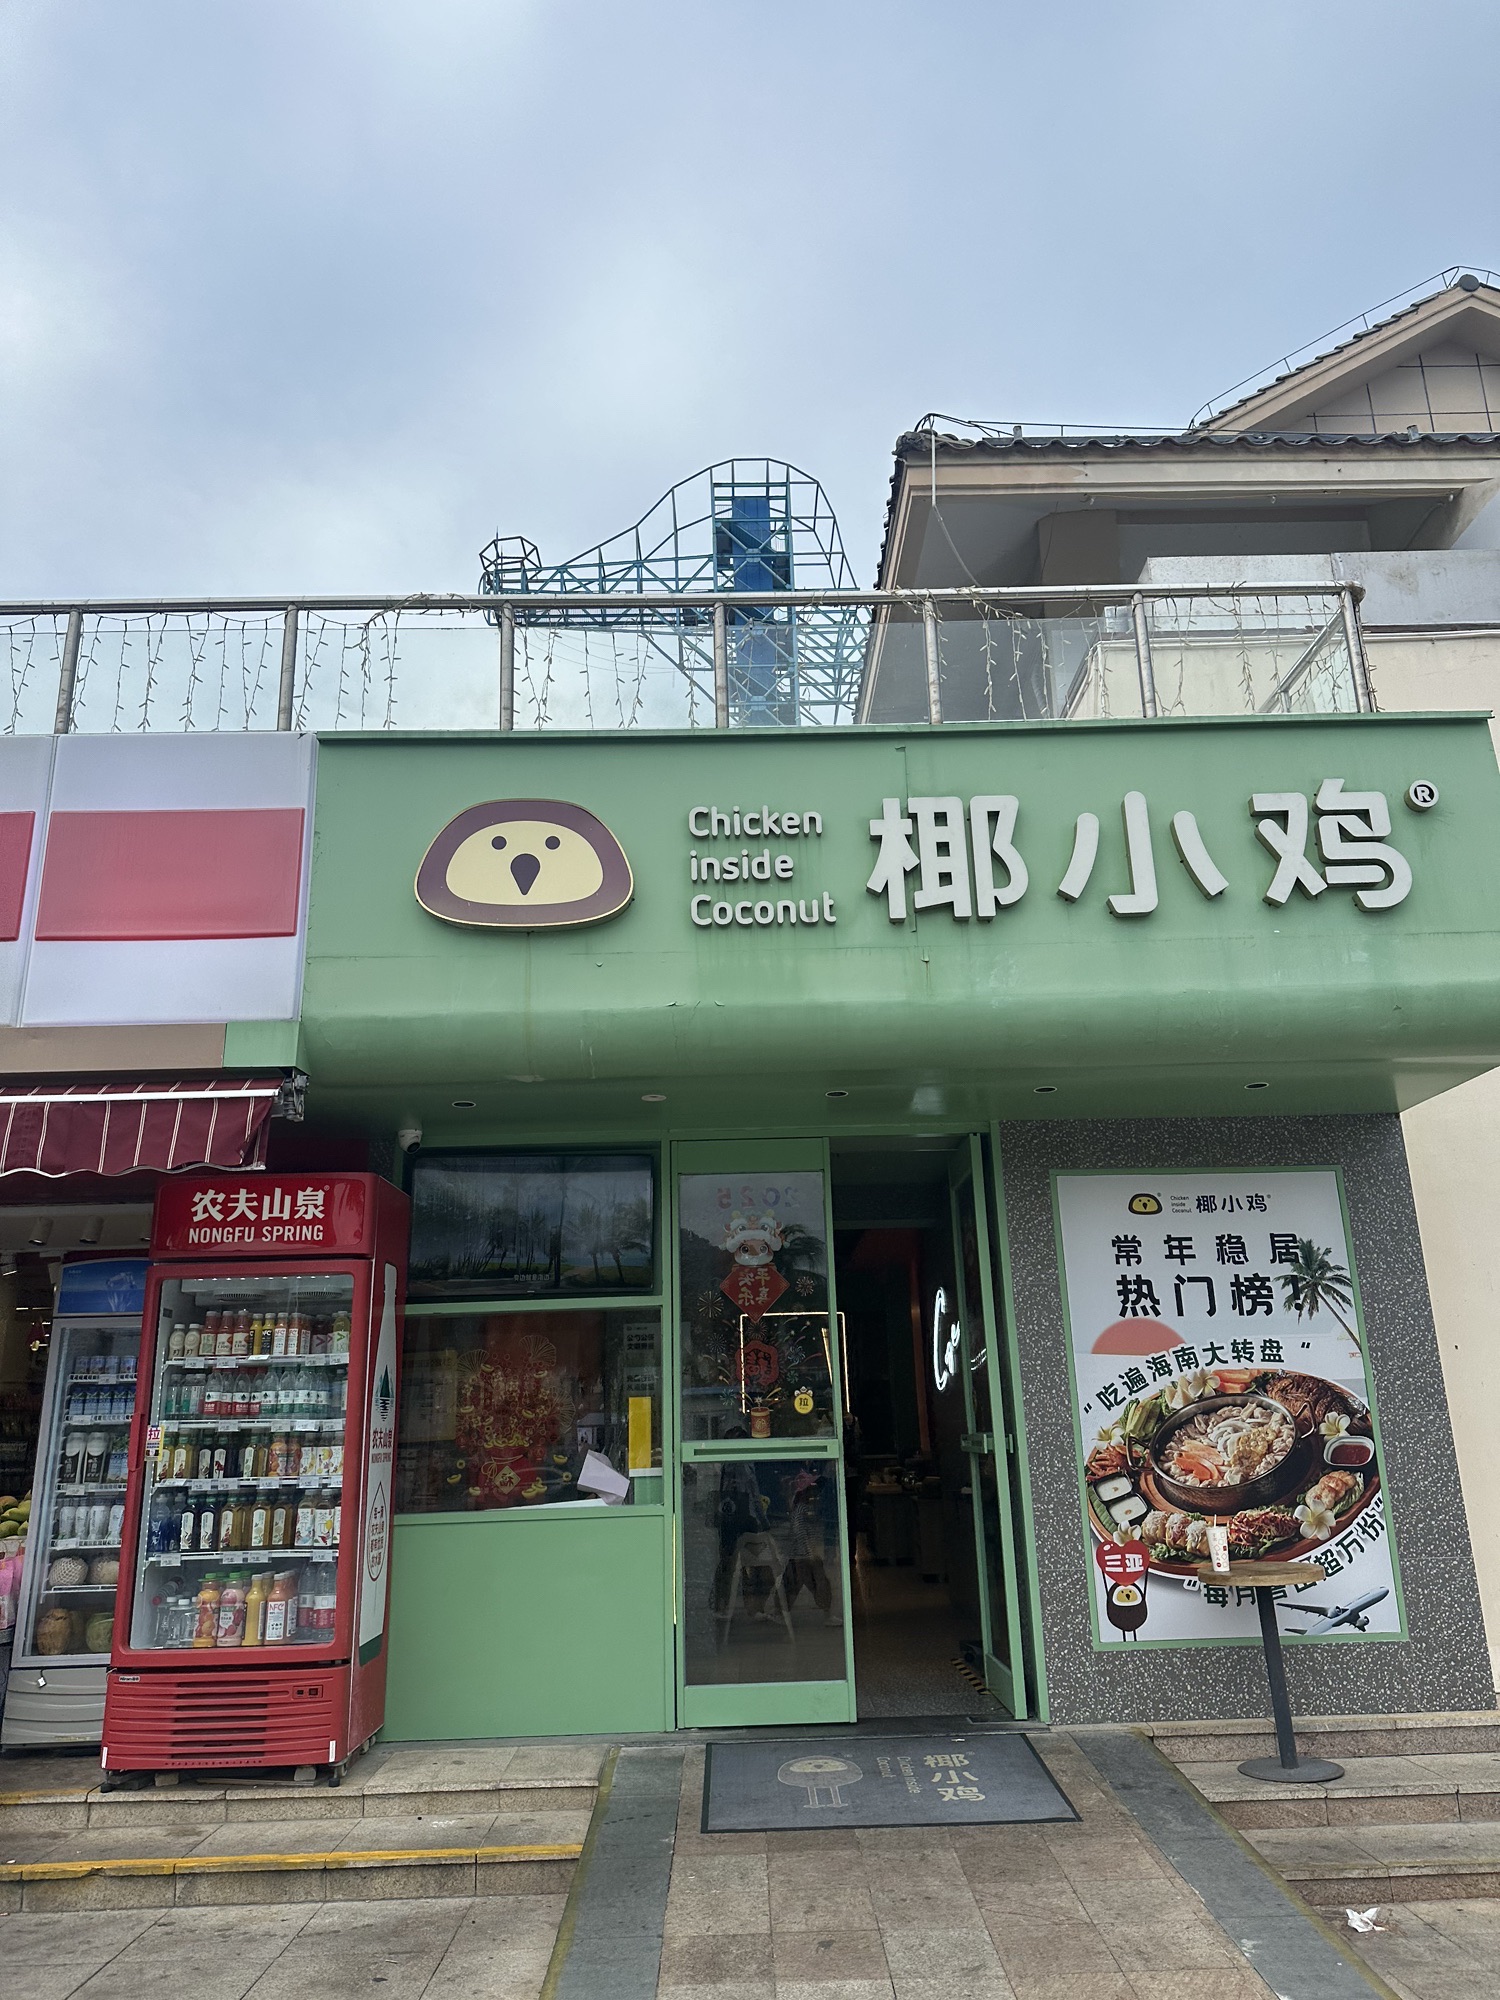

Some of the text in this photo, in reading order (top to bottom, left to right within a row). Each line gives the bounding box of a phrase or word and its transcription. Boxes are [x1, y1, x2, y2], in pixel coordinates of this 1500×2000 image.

[688, 804, 823, 837] Chicken
[689, 849, 794, 882] inside
[866, 777, 1413, 922] 椰小鸡
[690, 891, 837, 925] Coconut
[191, 1186, 325, 1222] 农夫山泉
[1195, 1193, 1268, 1214] 椰小鸡
[188, 1225, 324, 1244] NONGFU SPRING
[1111, 1232, 1301, 1267] 常年稳居
[148, 1427, 161, 1441] 拉
[1104, 1553, 1144, 1573] 三亚
[923, 1753, 986, 1802] 椰小鸡
